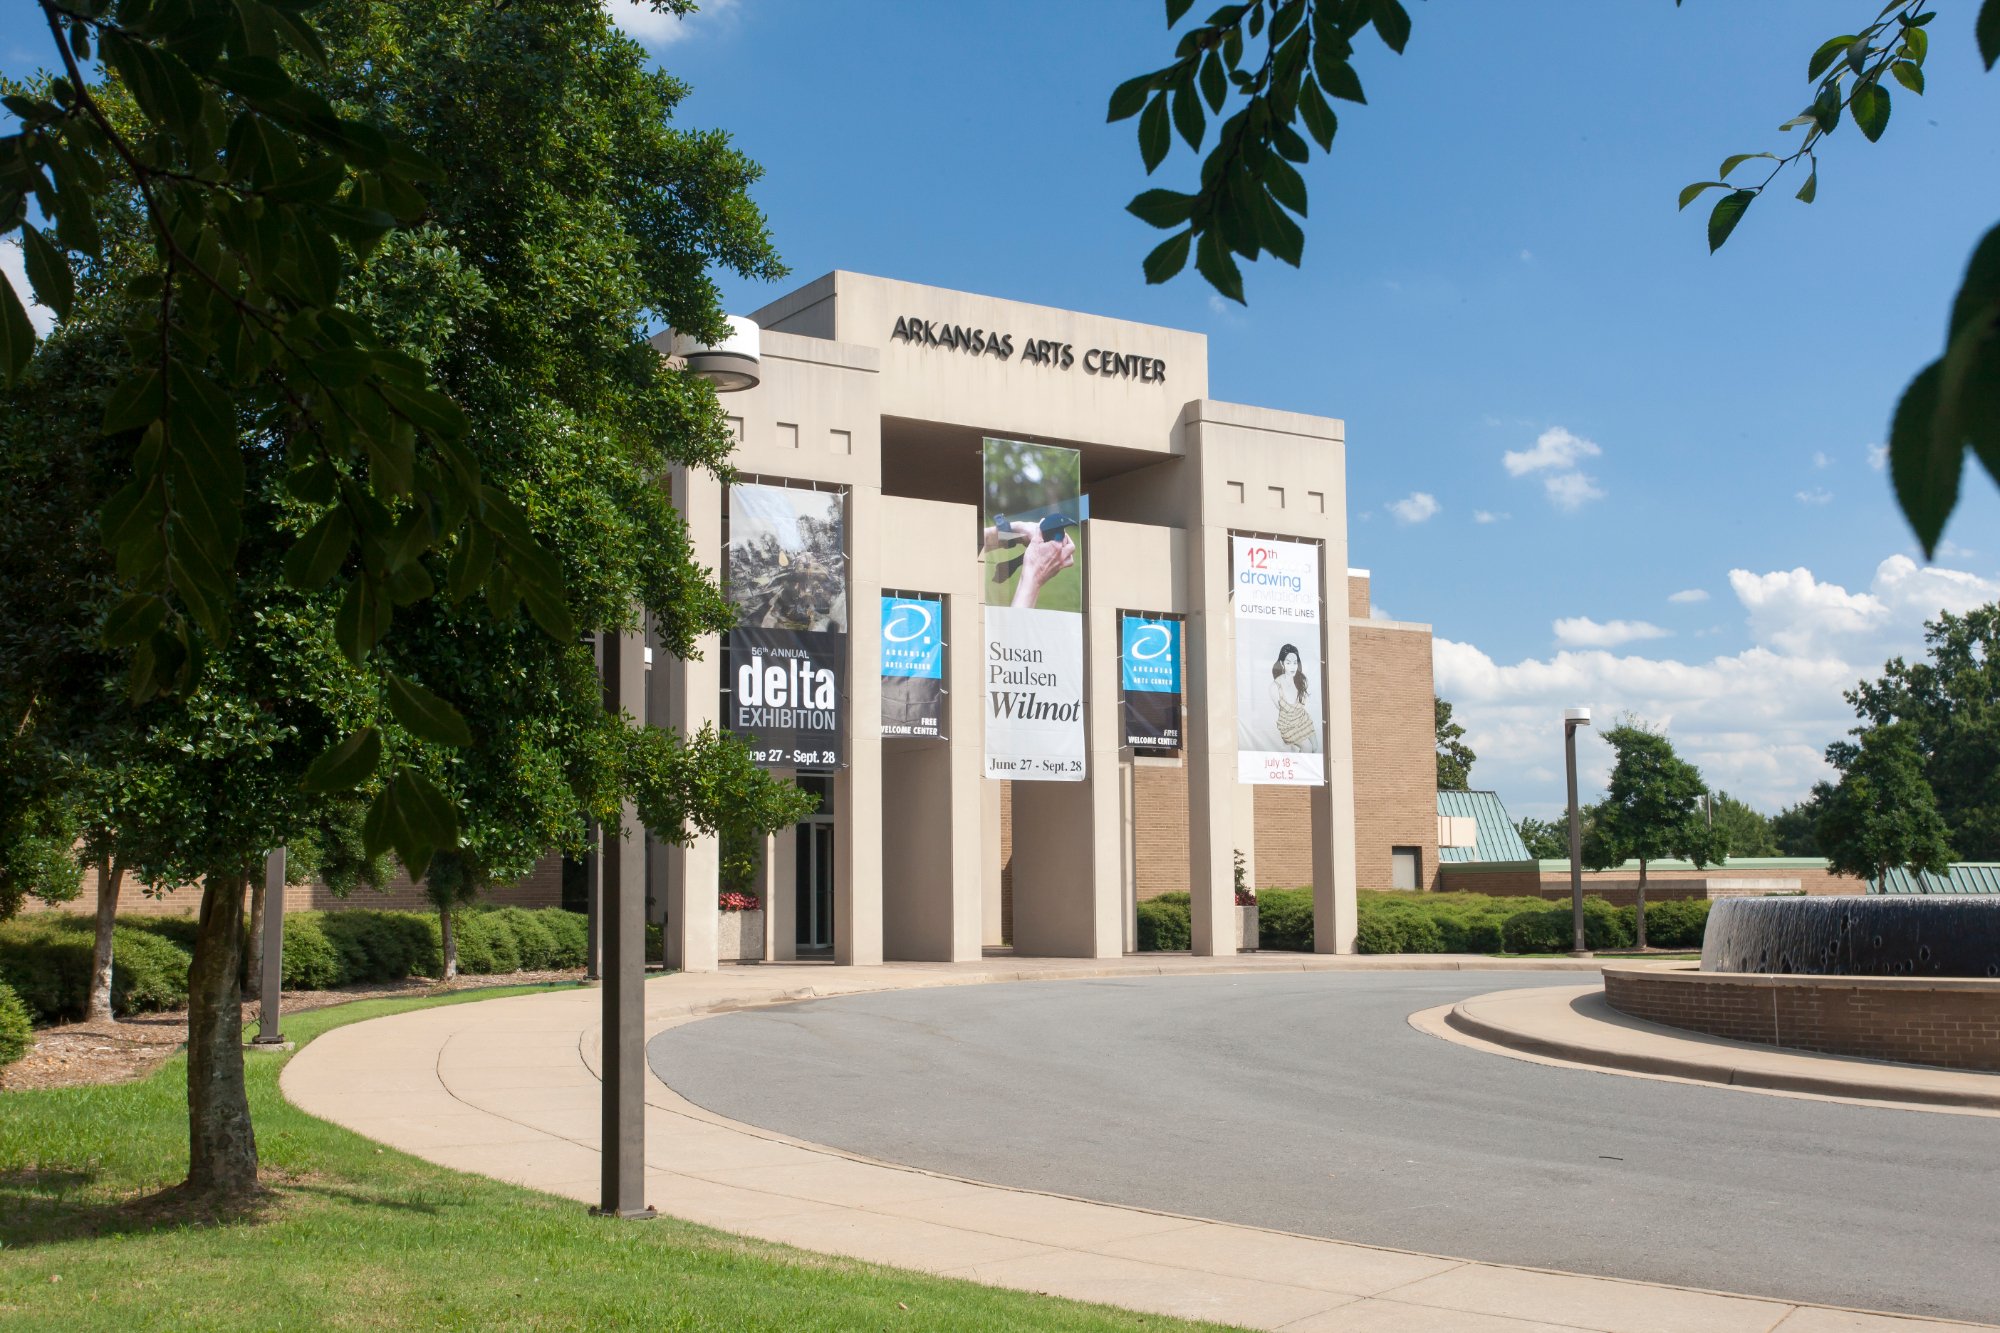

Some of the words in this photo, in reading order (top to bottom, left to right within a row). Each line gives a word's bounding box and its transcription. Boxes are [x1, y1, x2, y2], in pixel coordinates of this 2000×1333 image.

[890, 315, 1013, 358] ARKANSAS
[1020, 338, 1074, 370] ARTS
[1082, 348, 1166, 384] CENTER
[1247, 547, 1278, 569] 12th
[1240, 569, 1302, 593] drawing
[1240, 604, 1277, 615] OUTSIDE
[1278, 606, 1293, 616] THE
[1294, 608, 1315, 618] LINES
[751, 646, 769, 656] 56th
[770, 648, 810, 659] ANNUAL
[989, 641, 1043, 663] Susan
[738, 655, 835, 710] delta
[989, 664, 1057, 687] Paulsen
[989, 691, 1081, 722] Wilmot
[739, 707, 836, 731] EXHIBITION
[921, 717, 938, 726] FREE
[912, 726, 938, 736] CENTER
[1163, 729, 1178, 737] FREE
[1127, 736, 1157, 745] WELCOME
[1157, 737, 1178, 746] CENTER
[768, 749, 783, 762] 27
[793, 750, 820, 766] Sept.
[822, 751, 836, 764] 28
[1282, 758, 1291, 768] 18
[989, 758, 1017, 771] June
[1019, 759, 1033, 771] 27
[1042, 760, 1068, 774] Sept.
[1070, 761, 1082, 772] 28
[1269, 769, 1287, 780] oct.
[1288, 769, 1294, 780] 5
